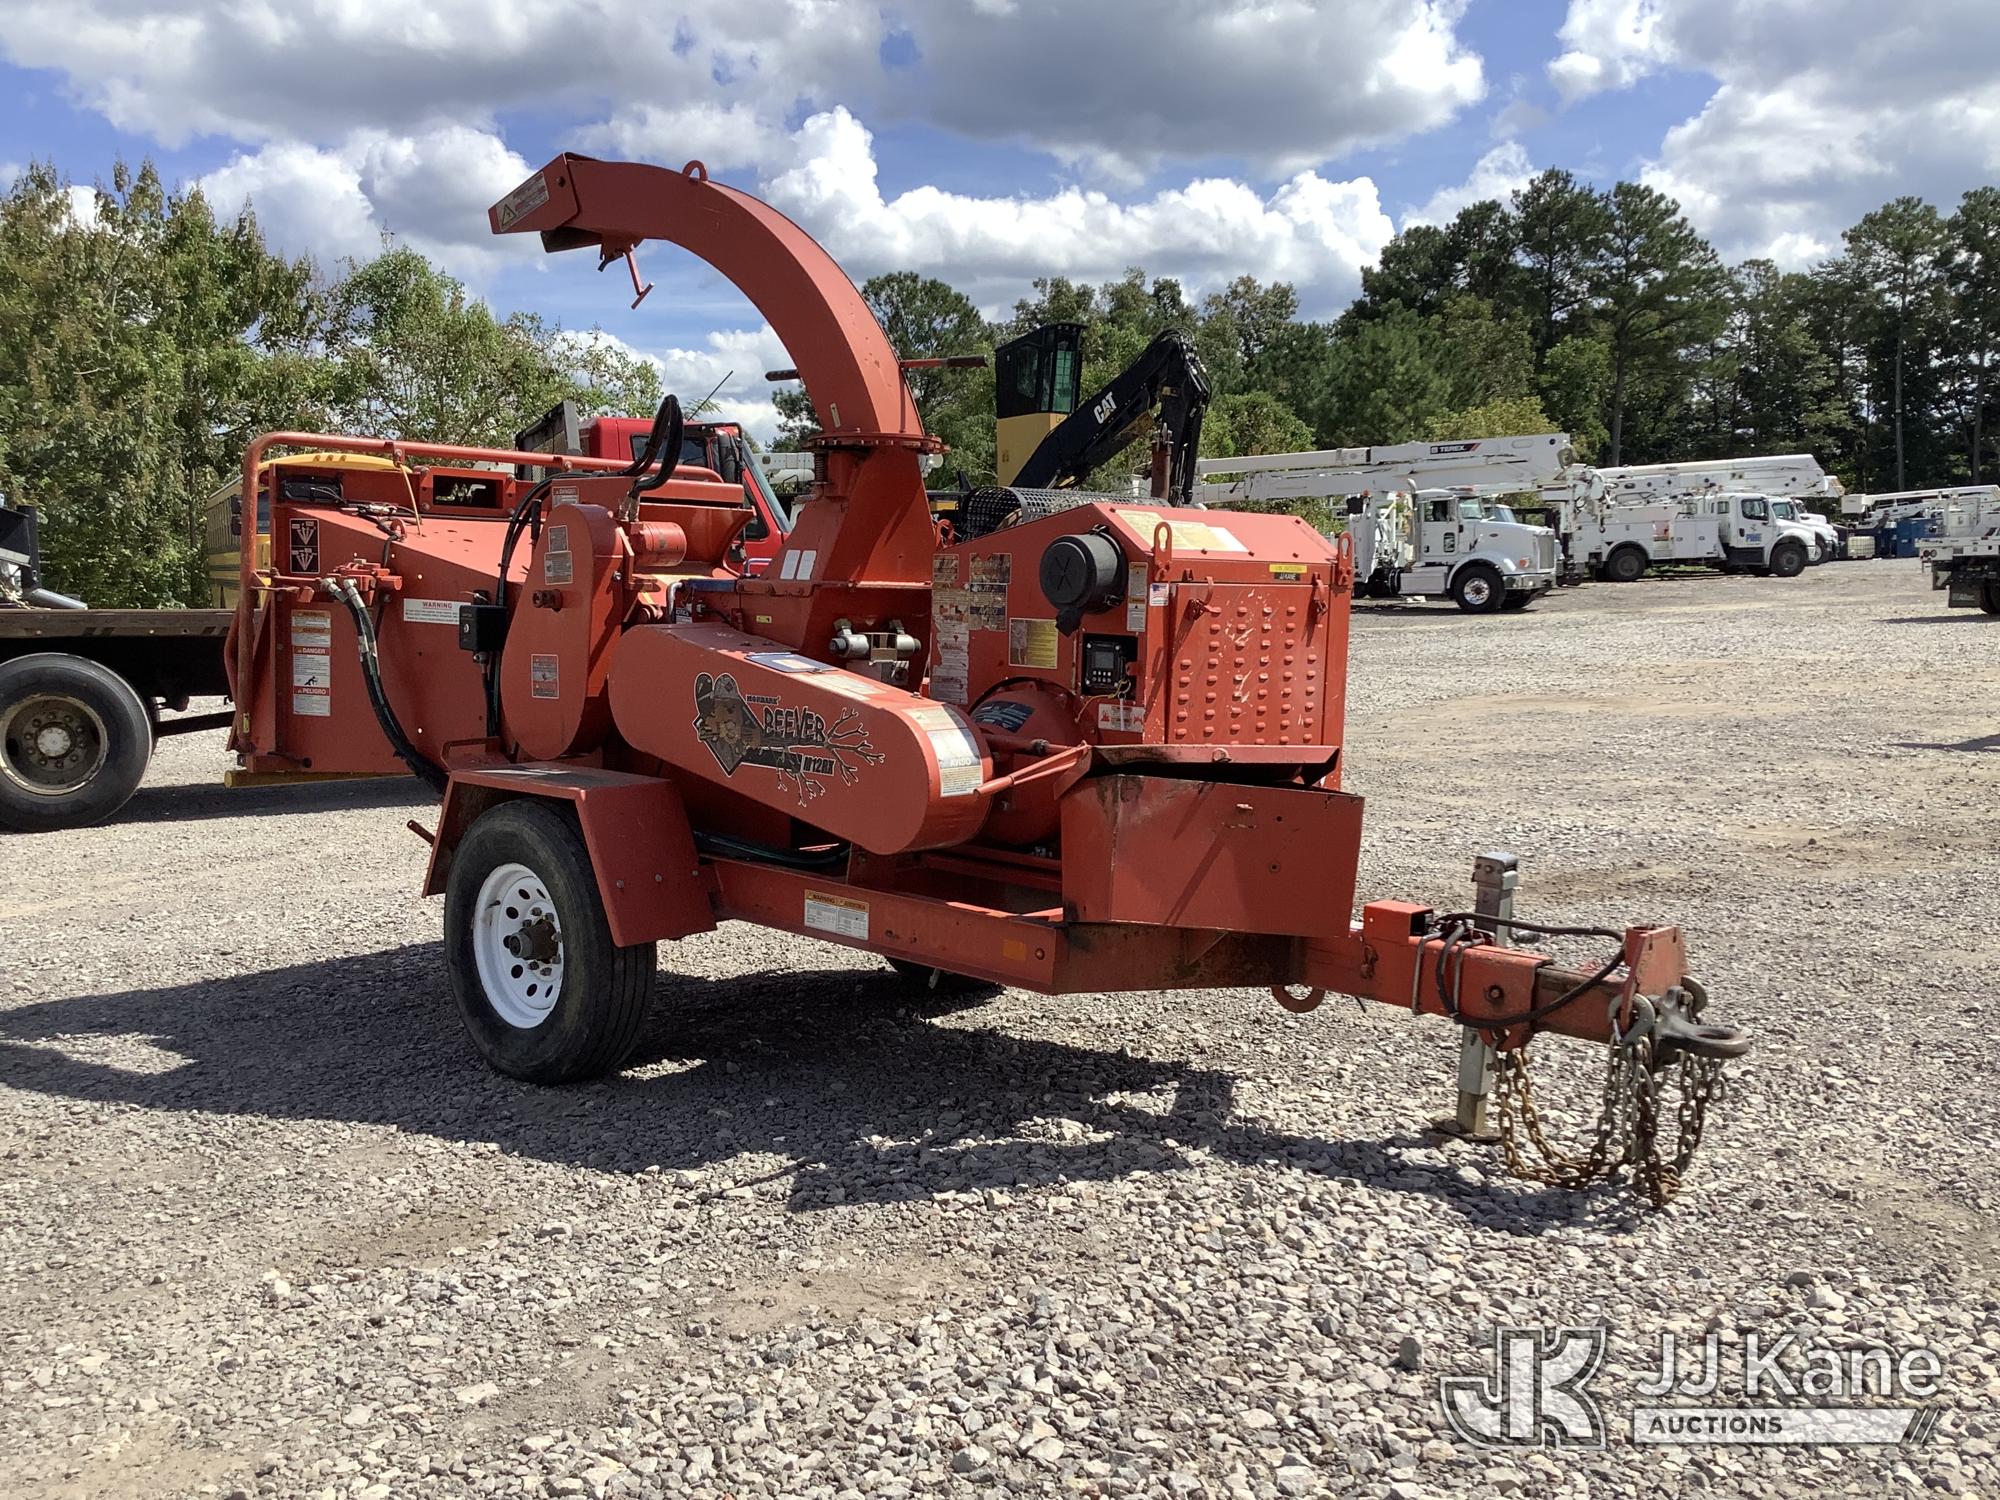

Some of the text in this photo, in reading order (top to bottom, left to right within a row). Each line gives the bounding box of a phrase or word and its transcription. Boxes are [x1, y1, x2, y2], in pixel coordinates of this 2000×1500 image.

[1093, 391, 1117, 424] CAT
[1439, 445, 1465, 453] TEREX
[422, 601, 453, 609] WARNING
[302, 687, 327, 695] PELIGRO
[763, 706, 827, 742] BEEVER
[803, 756, 835, 775] M12RX
